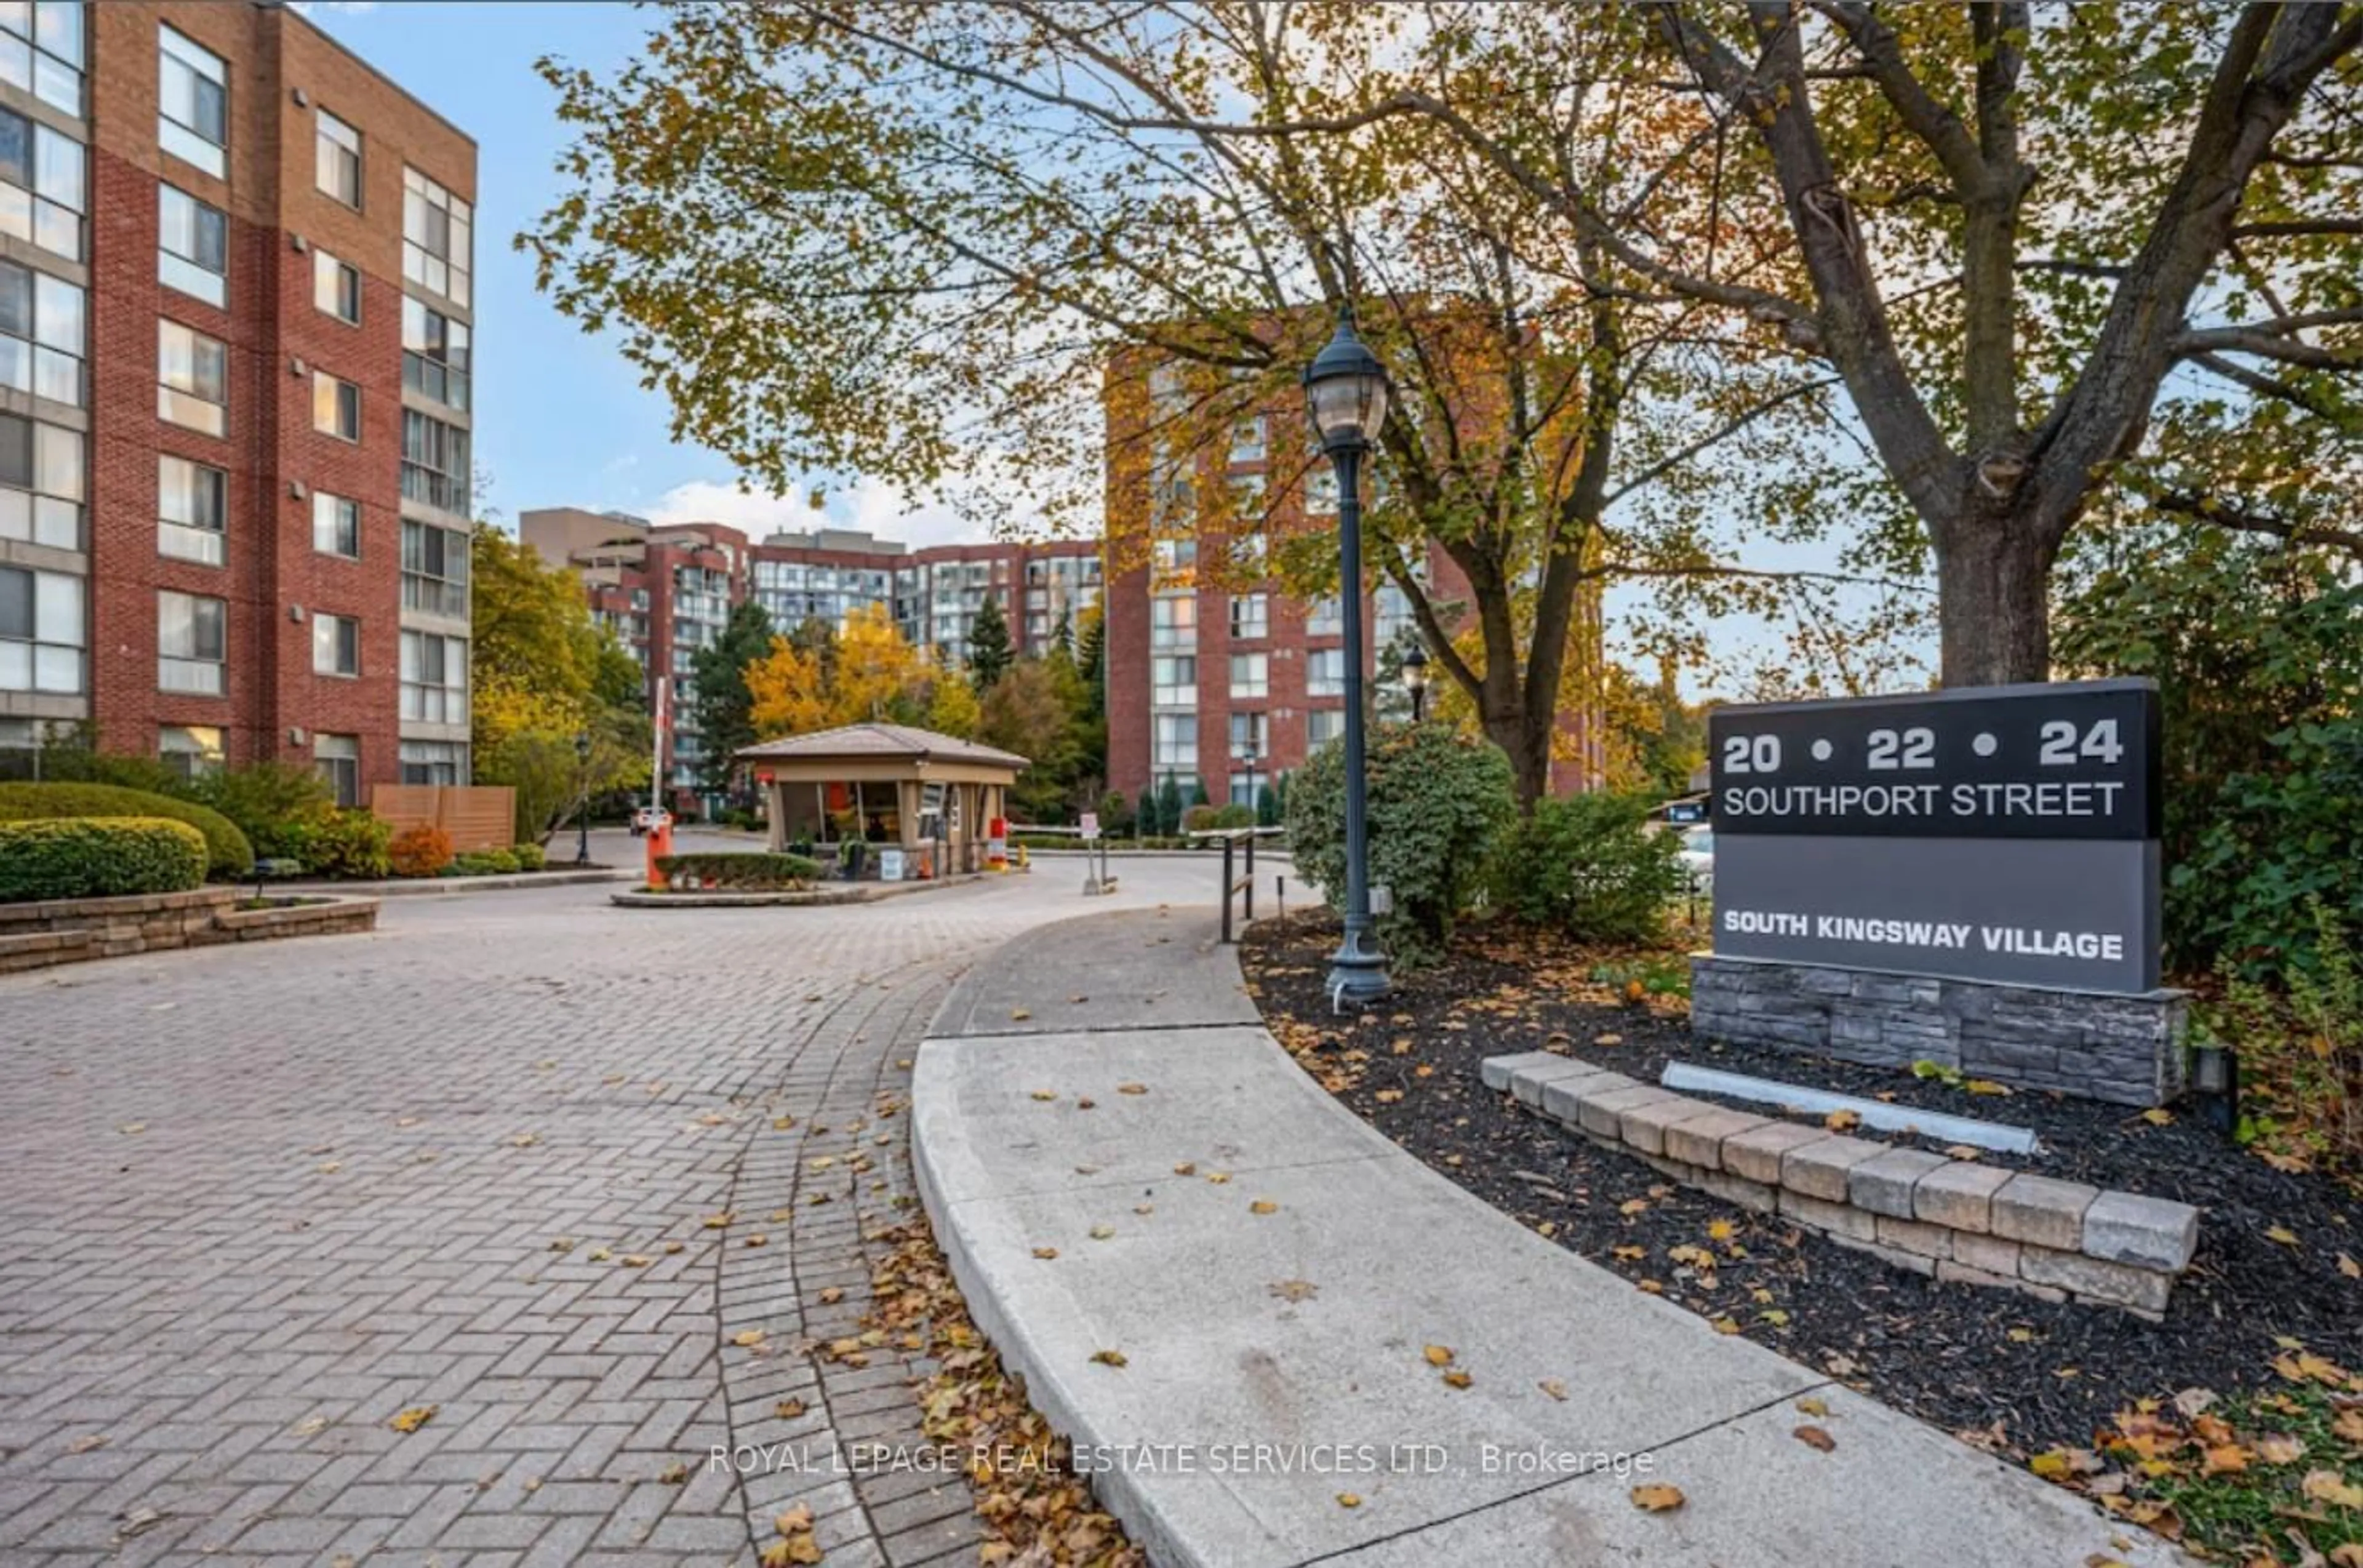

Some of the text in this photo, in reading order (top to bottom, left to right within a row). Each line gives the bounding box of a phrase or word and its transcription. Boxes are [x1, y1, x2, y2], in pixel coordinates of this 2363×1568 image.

[1724, 719, 2123, 773] 20 22 24
[1724, 782, 2124, 816] SOUTHPORT STREET
[1724, 910, 2122, 960] SOUTH KINGSWAY VILLAGE
